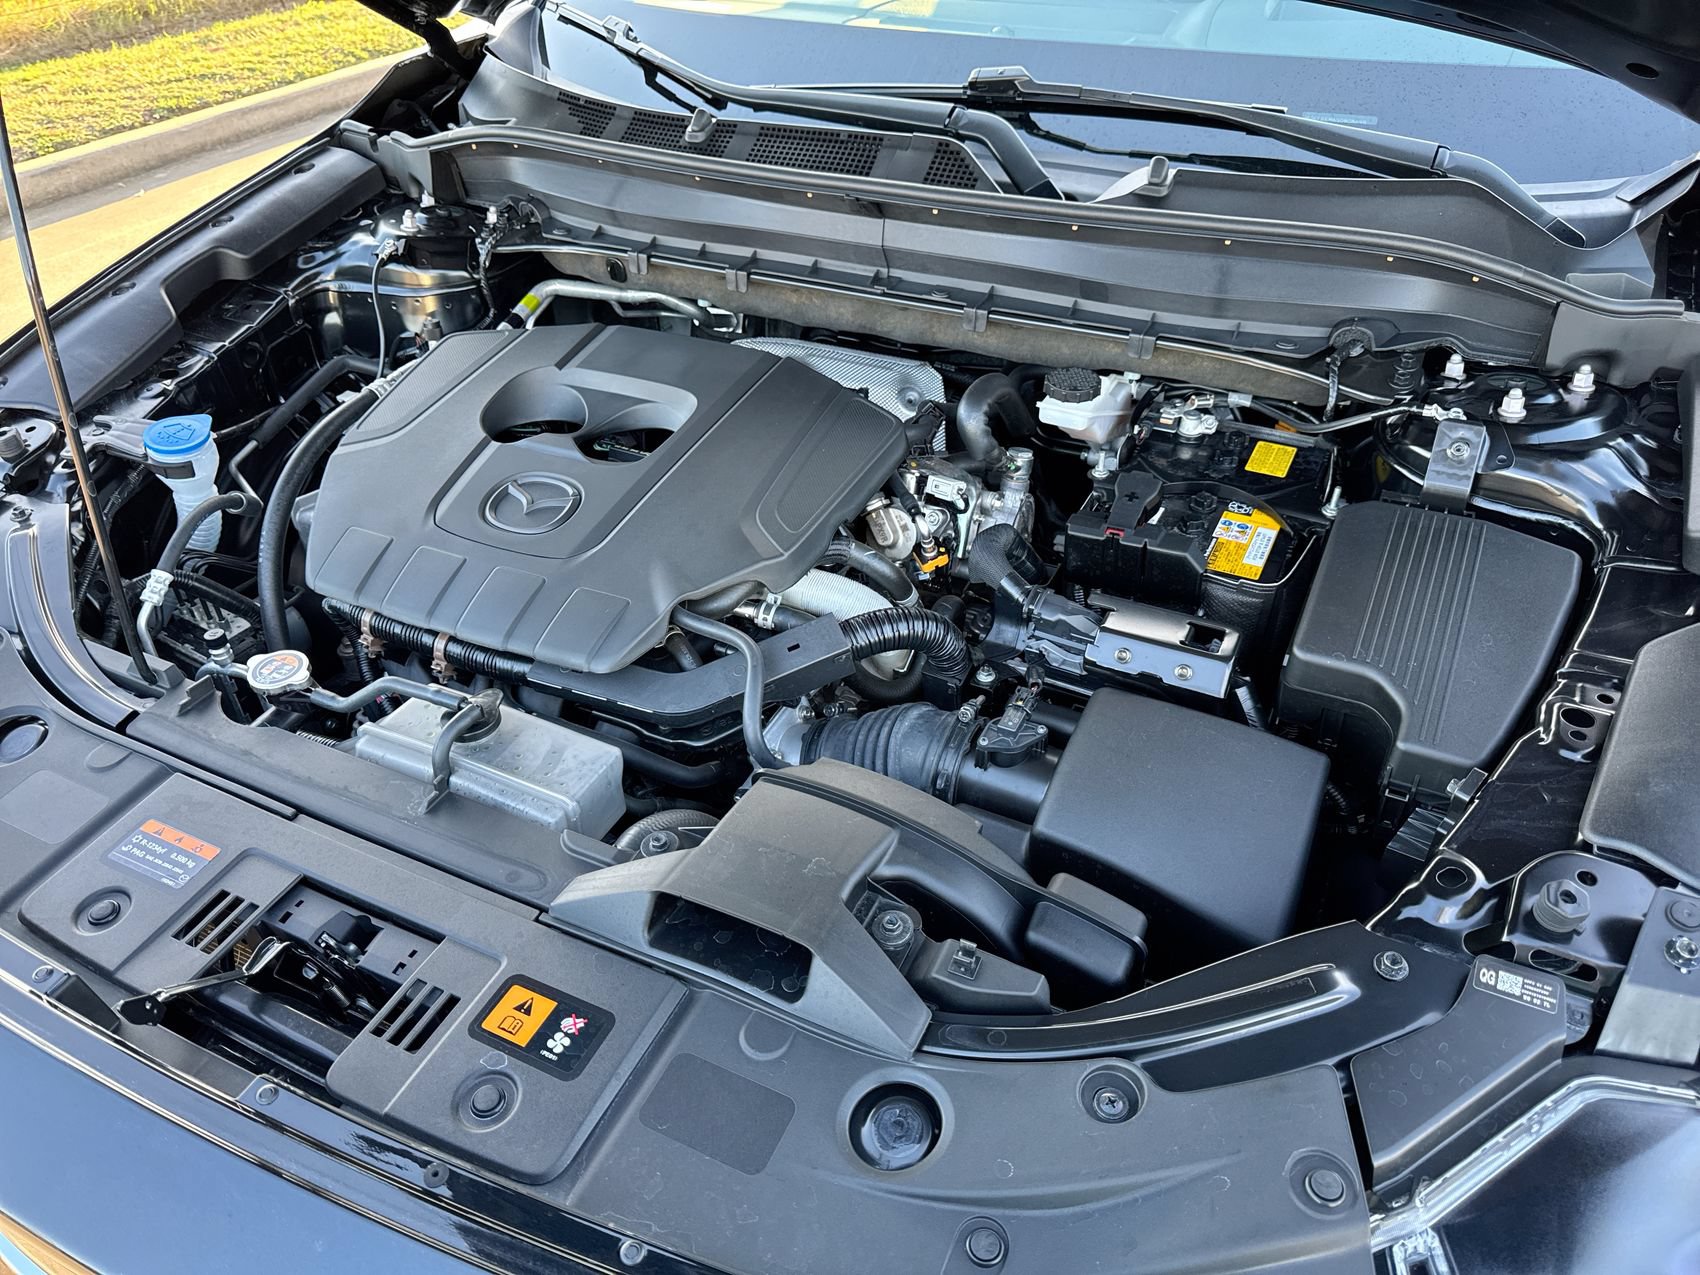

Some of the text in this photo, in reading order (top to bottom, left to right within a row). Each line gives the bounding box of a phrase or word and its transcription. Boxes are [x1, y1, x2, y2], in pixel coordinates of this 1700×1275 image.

[130, 847, 146, 857] PAG
[140, 839, 168, 854] R-1234yf
[186, 858, 196, 869] kg
[1480, 968, 1496, 986] QG
